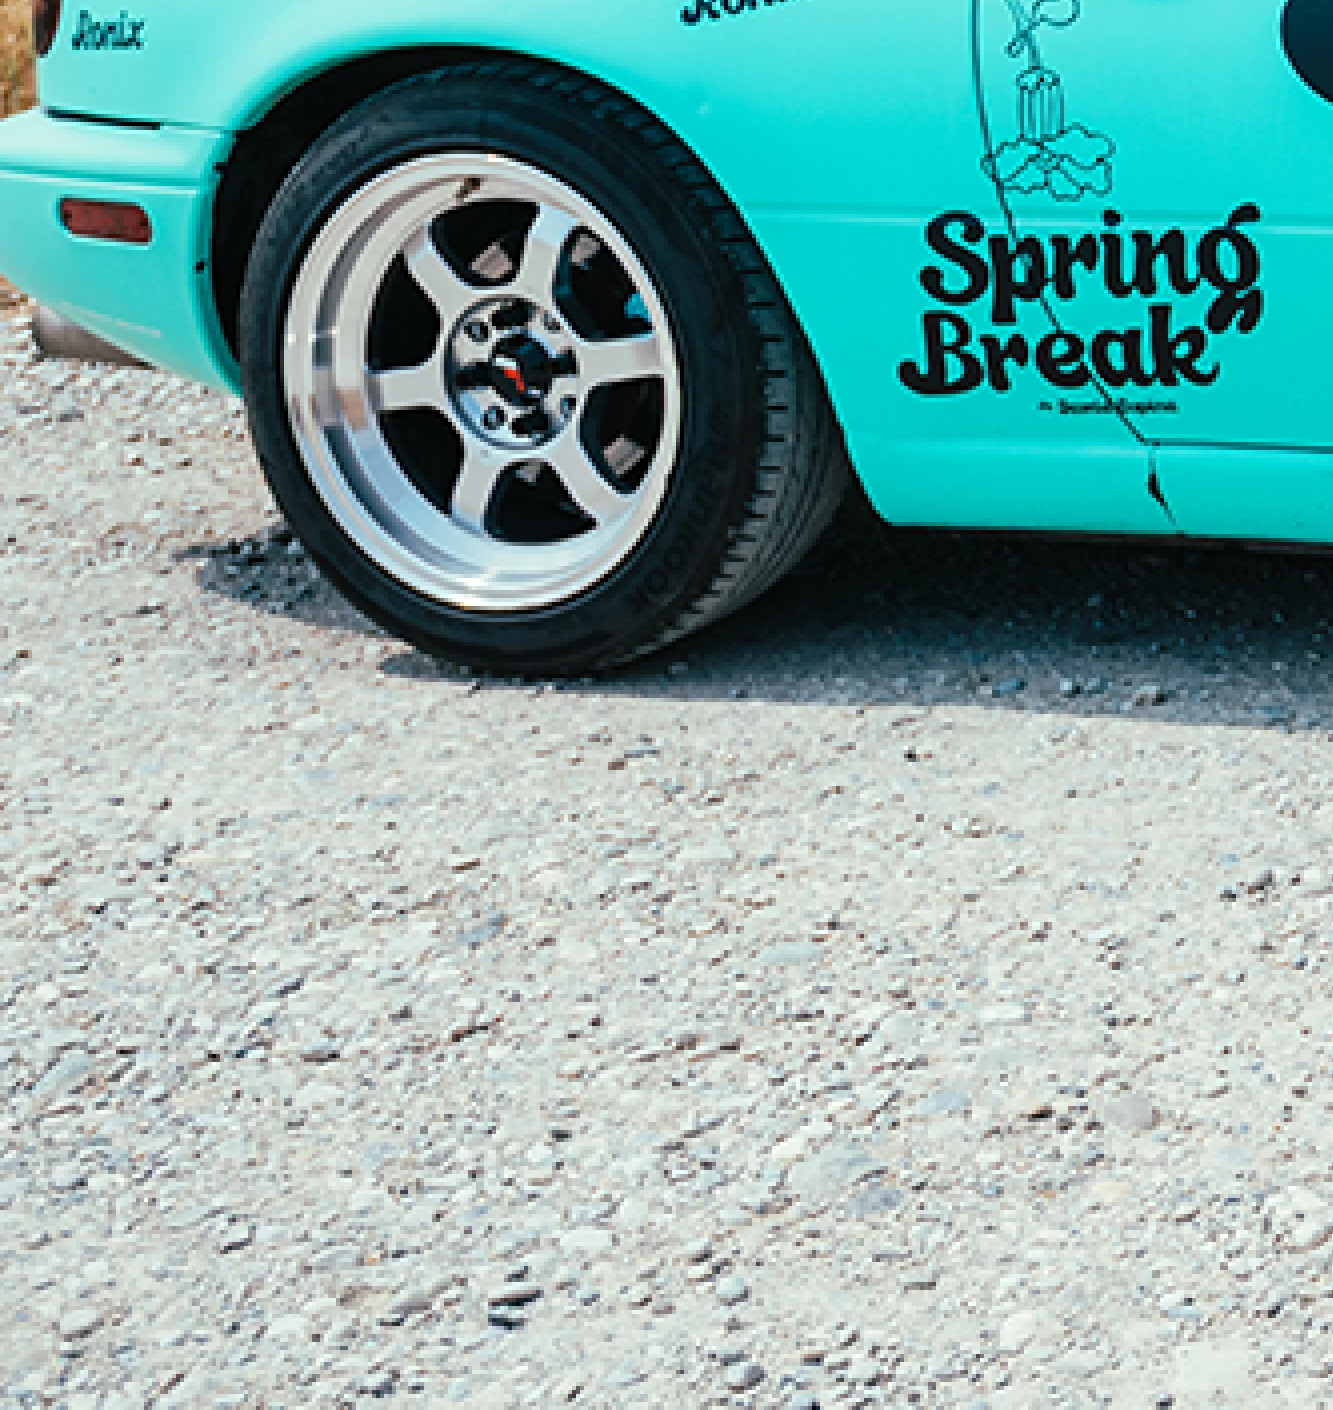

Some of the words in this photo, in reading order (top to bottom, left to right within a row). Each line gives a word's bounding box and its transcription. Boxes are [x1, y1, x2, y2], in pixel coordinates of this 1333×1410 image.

[72, 10, 145, 50] Ronix
[919, 202, 1264, 333] Spring
[898, 305, 1221, 395] Break
